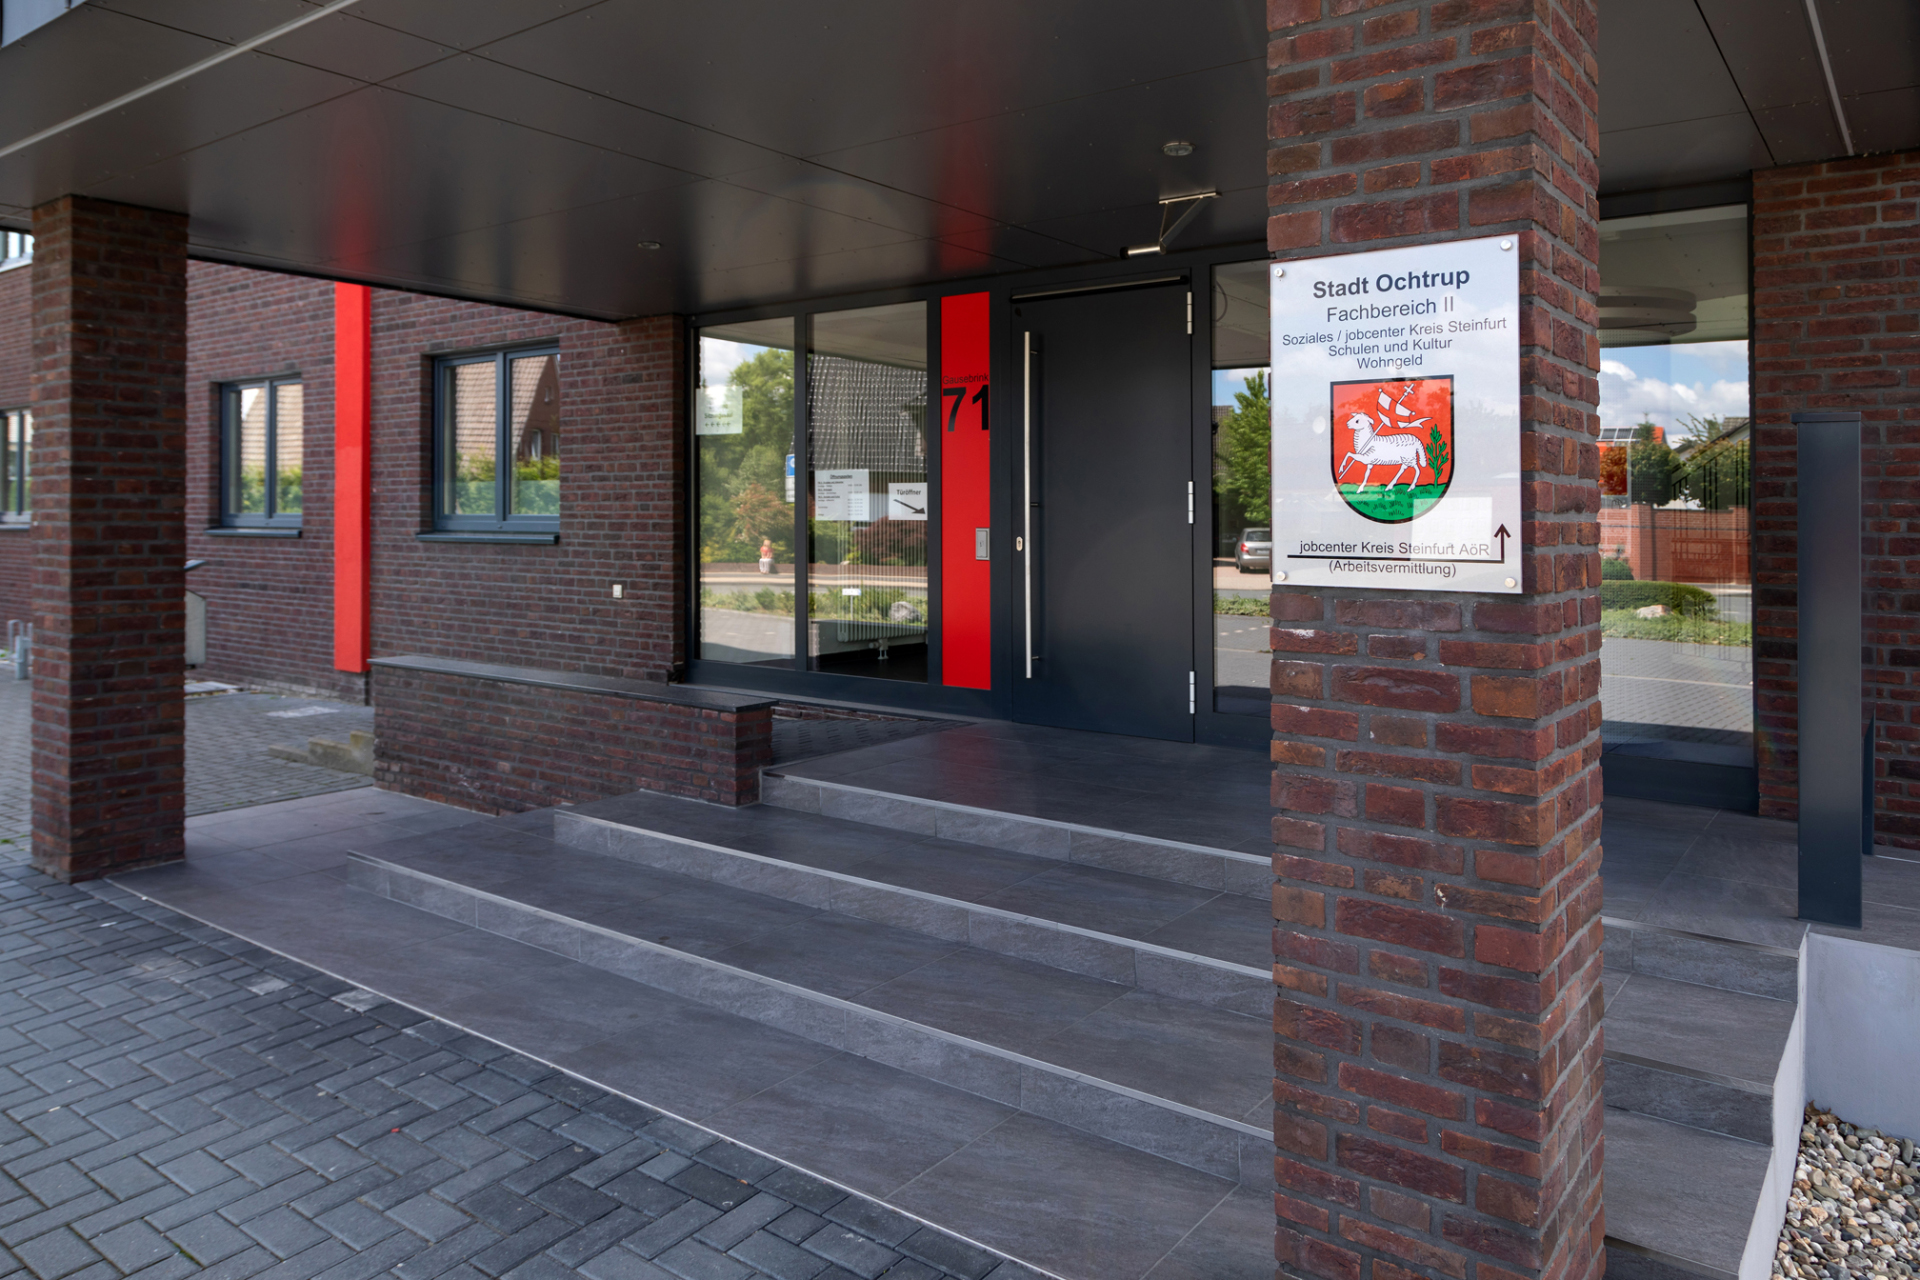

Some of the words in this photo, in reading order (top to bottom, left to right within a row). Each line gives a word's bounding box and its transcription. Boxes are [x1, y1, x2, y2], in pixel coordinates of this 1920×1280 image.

[1313, 277, 1369, 298] Stadt
[1376, 269, 1470, 292] Ochtrup
[1327, 298, 1436, 322] Fachbereich
[1444, 296, 1454, 312] II
[1282, 331, 1333, 346] Soziales
[1345, 325, 1405, 343] jobcenter
[1409, 323, 1443, 335] Kreis
[1448, 317, 1507, 333] Steinfurt
[1328, 343, 1380, 356] Schulen
[1384, 341, 1408, 352] und
[1413, 338, 1452, 350] Kultur
[1357, 355, 1423, 369] Wohngeld
[942, 373, 989, 384] Gausebrink
[943, 384, 989, 432] 71
[1300, 540, 1357, 555] jobcenter
[1361, 542, 1394, 553] Kreis
[1399, 543, 1455, 555] Steinfurt
[1459, 543, 1490, 555] AöR
[1329, 560, 1457, 577] (Arbeitsvermittlung)
